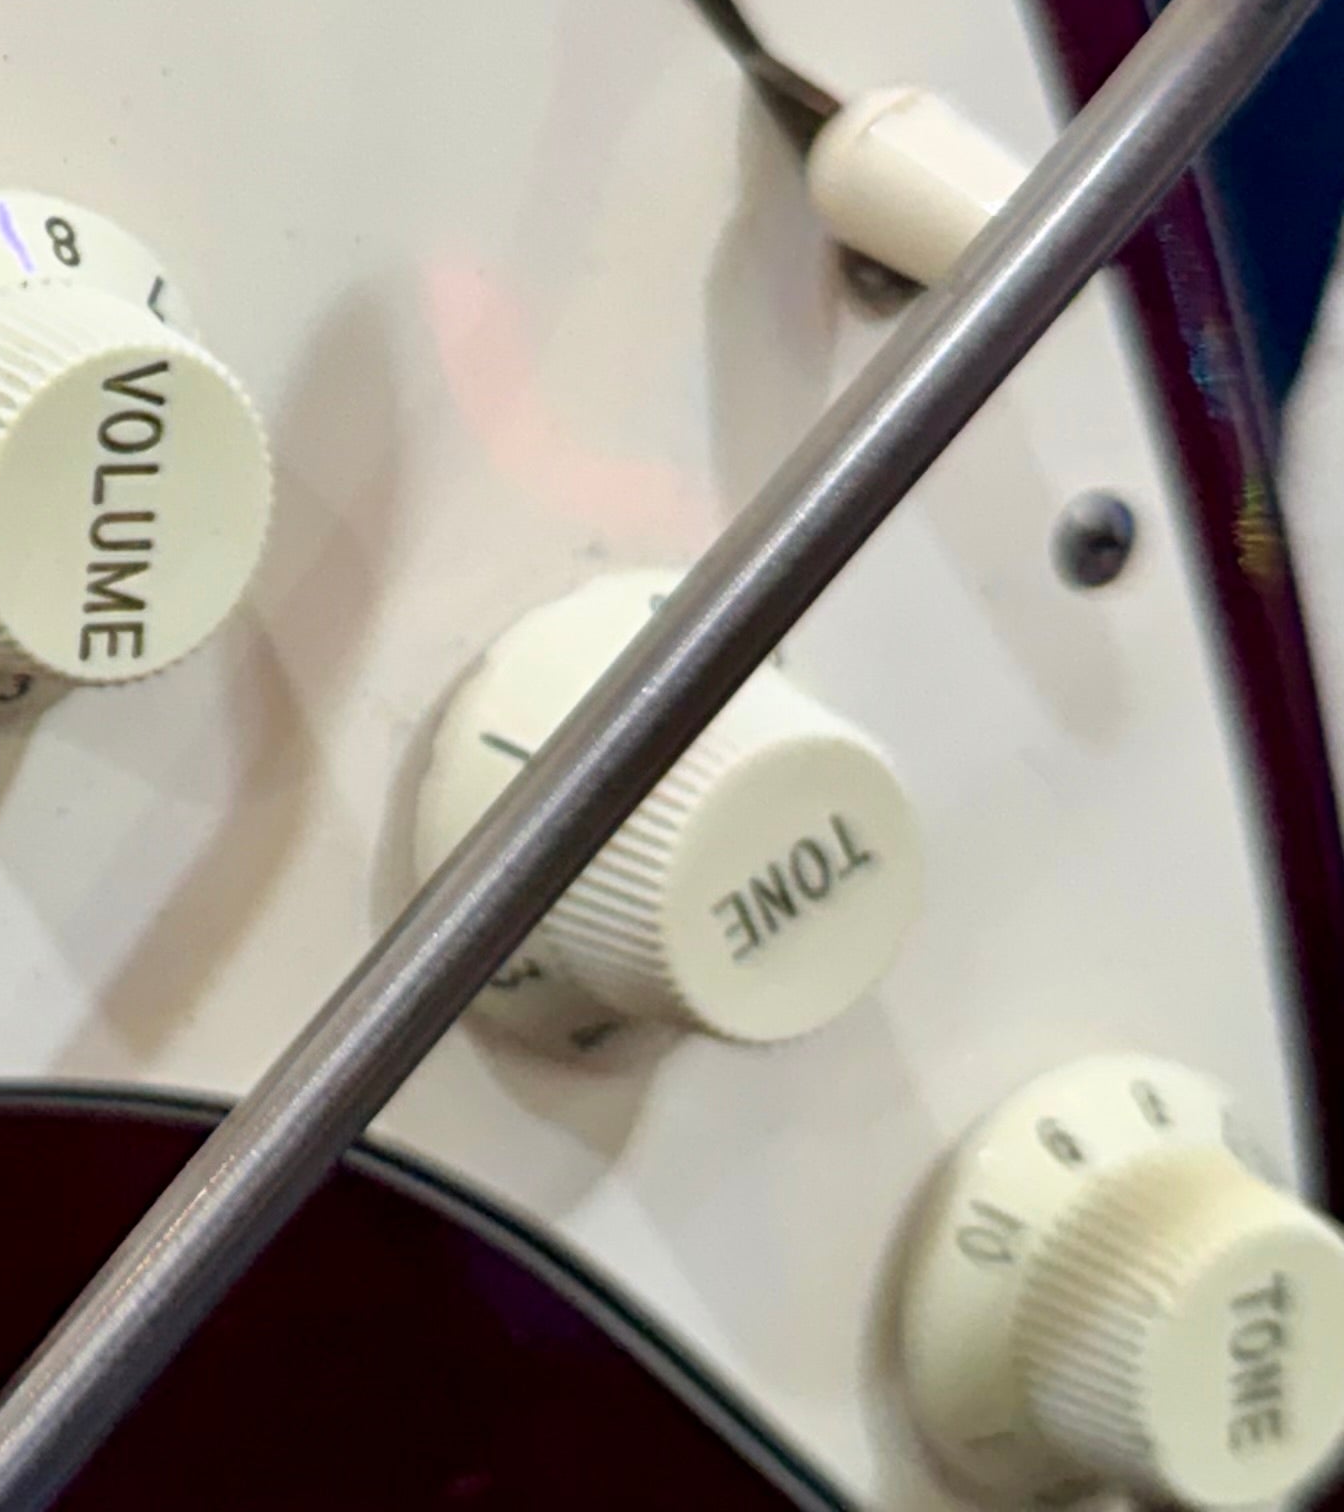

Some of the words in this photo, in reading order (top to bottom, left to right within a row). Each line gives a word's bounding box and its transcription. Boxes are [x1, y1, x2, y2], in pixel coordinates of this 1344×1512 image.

[45, 216, 81, 267] 8
[79, 360, 169, 661] VOLUME
[710, 812, 875, 962] TONE
[1226, 1271, 1290, 1456] TONE
